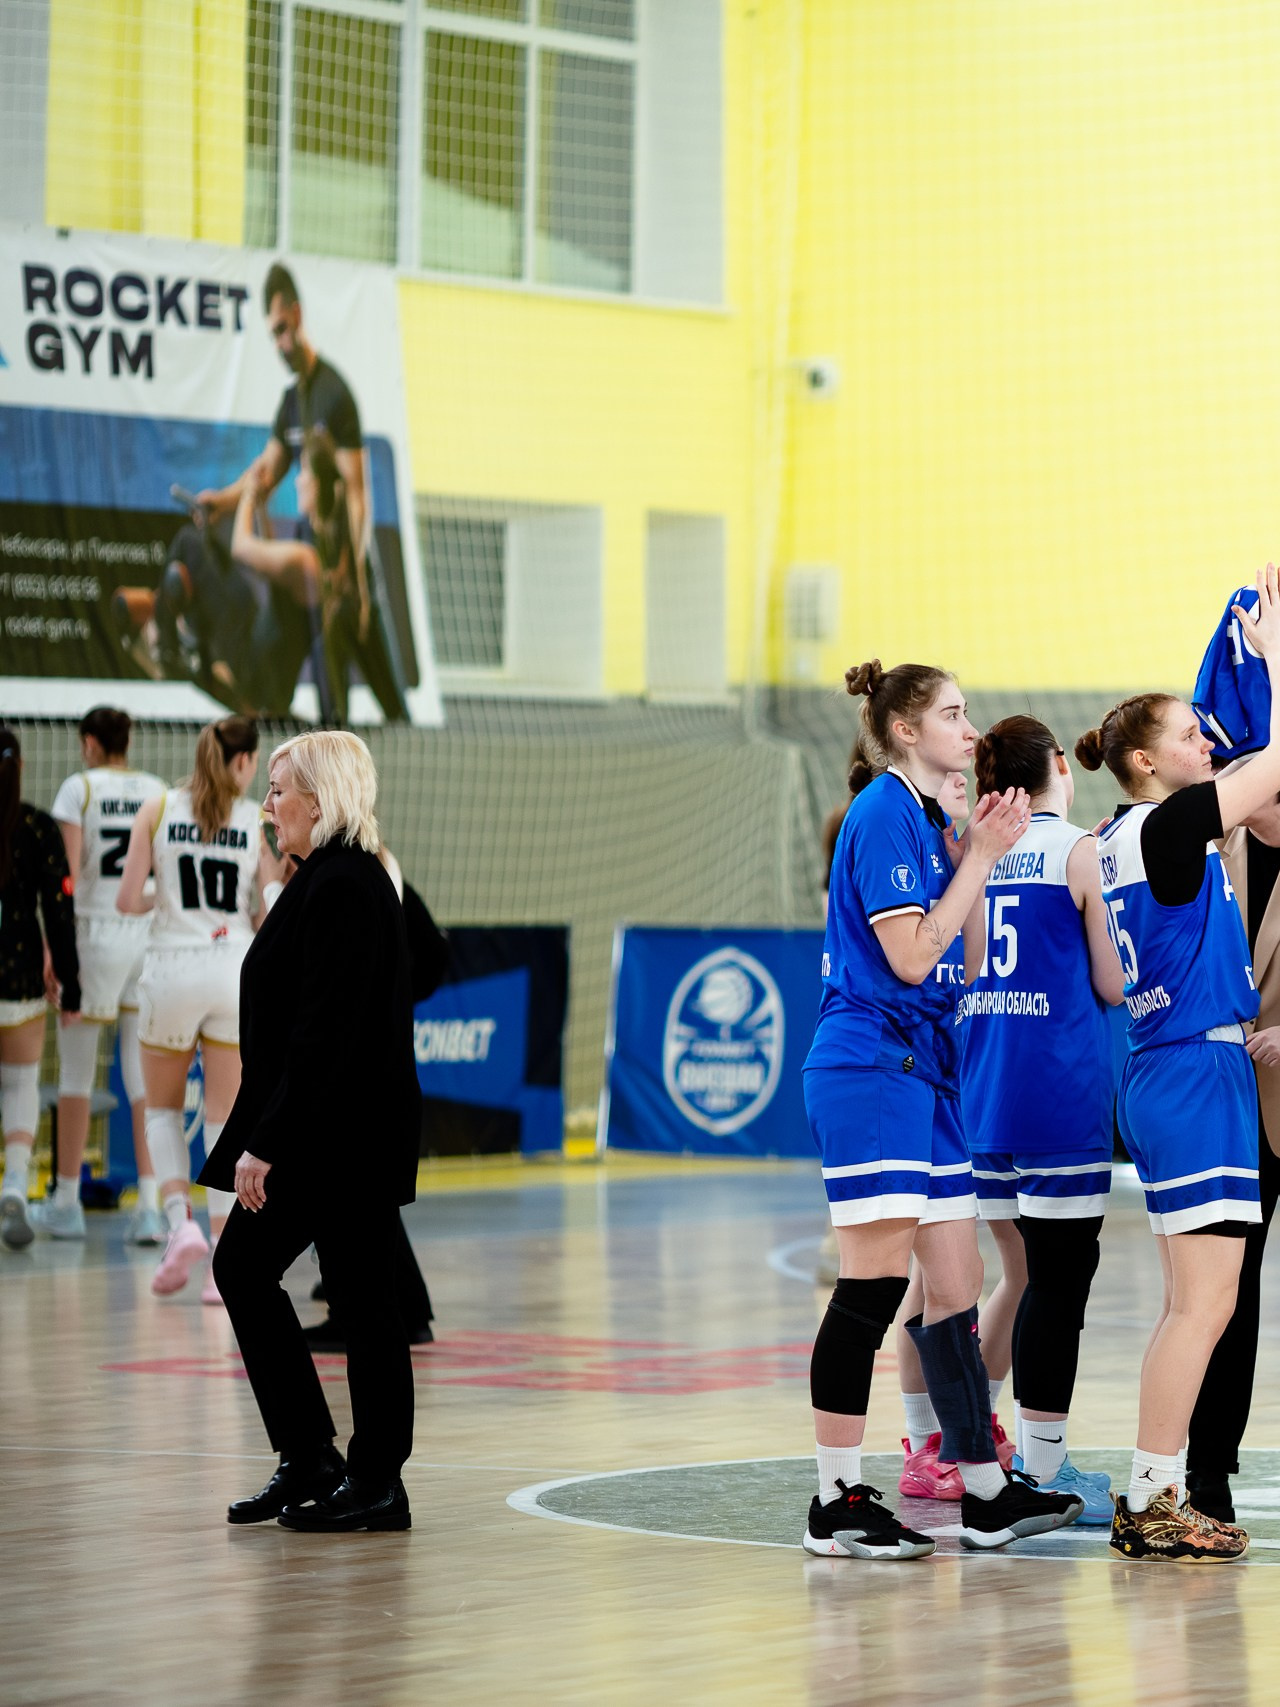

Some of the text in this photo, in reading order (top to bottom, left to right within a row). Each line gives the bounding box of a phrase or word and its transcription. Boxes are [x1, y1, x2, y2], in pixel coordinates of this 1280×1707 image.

[22, 262, 250, 332] ROCKET
[26, 319, 154, 381] GYM
[179, 855, 239, 912] 10
[936, 963, 957, 984] ГК
[1006, 990, 1050, 1016] ОБЛАСТЬ
